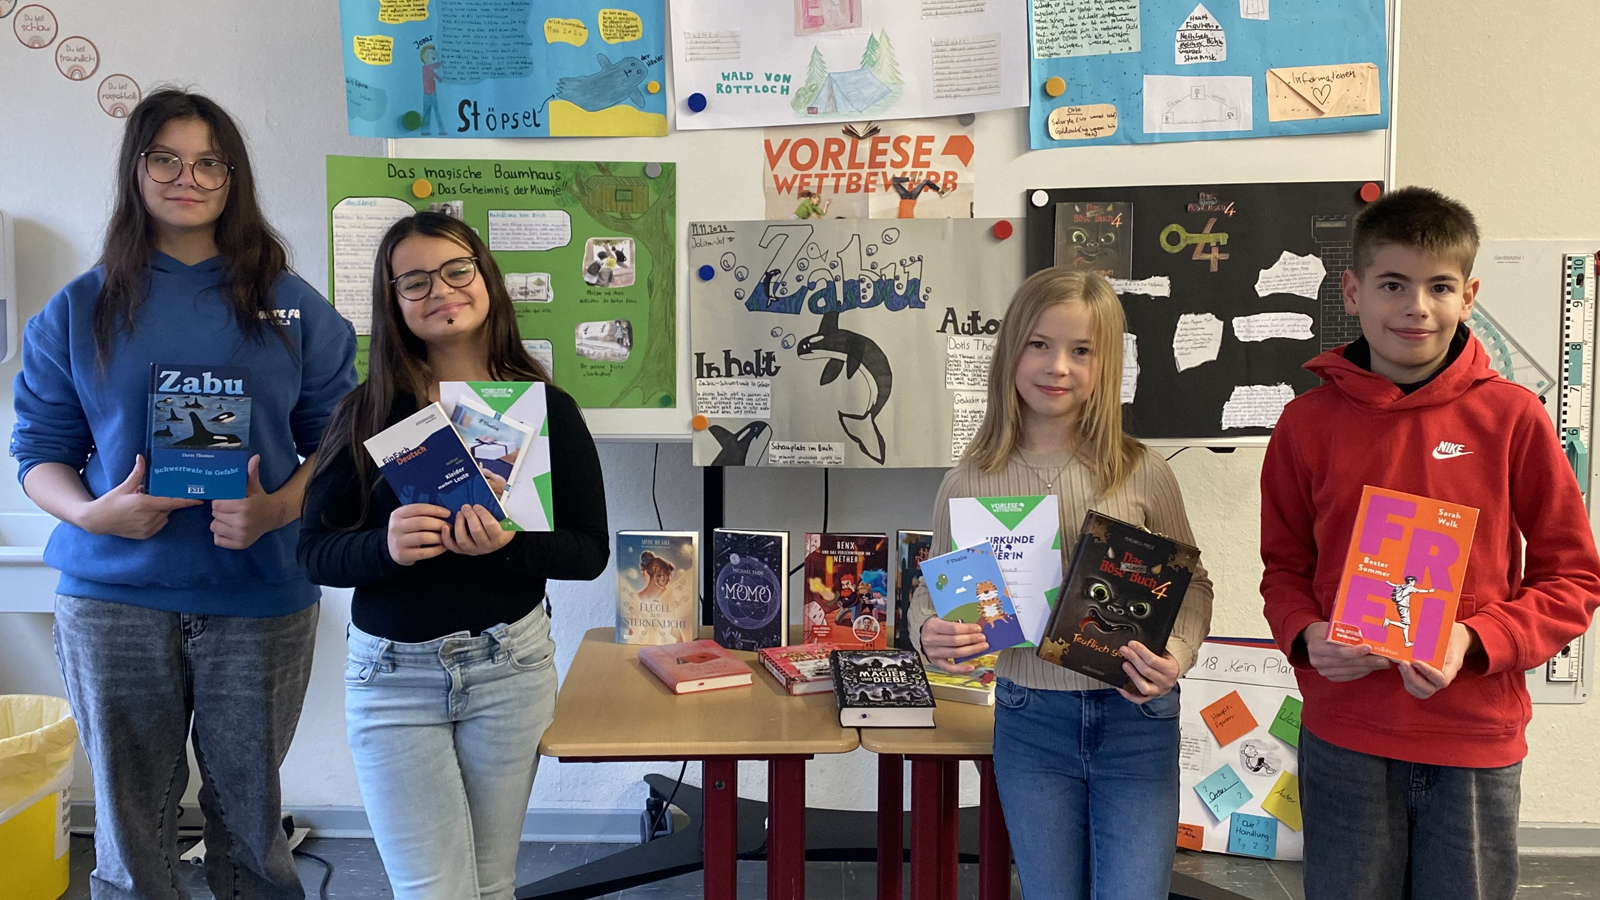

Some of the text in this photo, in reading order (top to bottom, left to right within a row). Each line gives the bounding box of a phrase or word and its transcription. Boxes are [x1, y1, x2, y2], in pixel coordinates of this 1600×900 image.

[721, 72, 792, 84] WALD VON
[716, 83, 790, 96] ROTTLOCH
[457, 99, 541, 133] Stöpsel
[764, 134, 936, 172] VORLESE
[388, 163, 562, 181] Das magische Baumhaus
[460, 183, 510, 195] Geheimnis
[514, 184, 529, 195] der
[1224, 201, 1236, 216] 4
[1111, 212, 1122, 228] 4
[1192, 217, 1230, 272] 4
[745, 224, 926, 315] Zabu
[936, 306, 1002, 336] Auto
[948, 336, 996, 352] Doris Tho
[158, 370, 245, 394] Zabu
[1438, 440, 1466, 454] NIKE
[396, 446, 427, 466] Deutsch
[154, 466, 239, 476] Schwertwale in Gefahr
[445, 466, 465, 480] Kleider
[454, 472, 470, 483] Leute
[1438, 508, 1462, 520] Sarah
[1438, 517, 1458, 529] Welk
[836, 541, 856, 550] BENX
[950, 555, 968, 564] Thalia
[1123, 552, 1144, 566] Das
[1364, 556, 1389, 569] Bester
[1358, 564, 1390, 578] Sommer
[1100, 560, 1172, 600] Böse Buch 4
[724, 582, 772, 604] MOMO
[624, 618, 687, 629] STERNENLICHT
[1073, 633, 1110, 654] Teuflisch
[1201, 656, 1218, 670] 18
